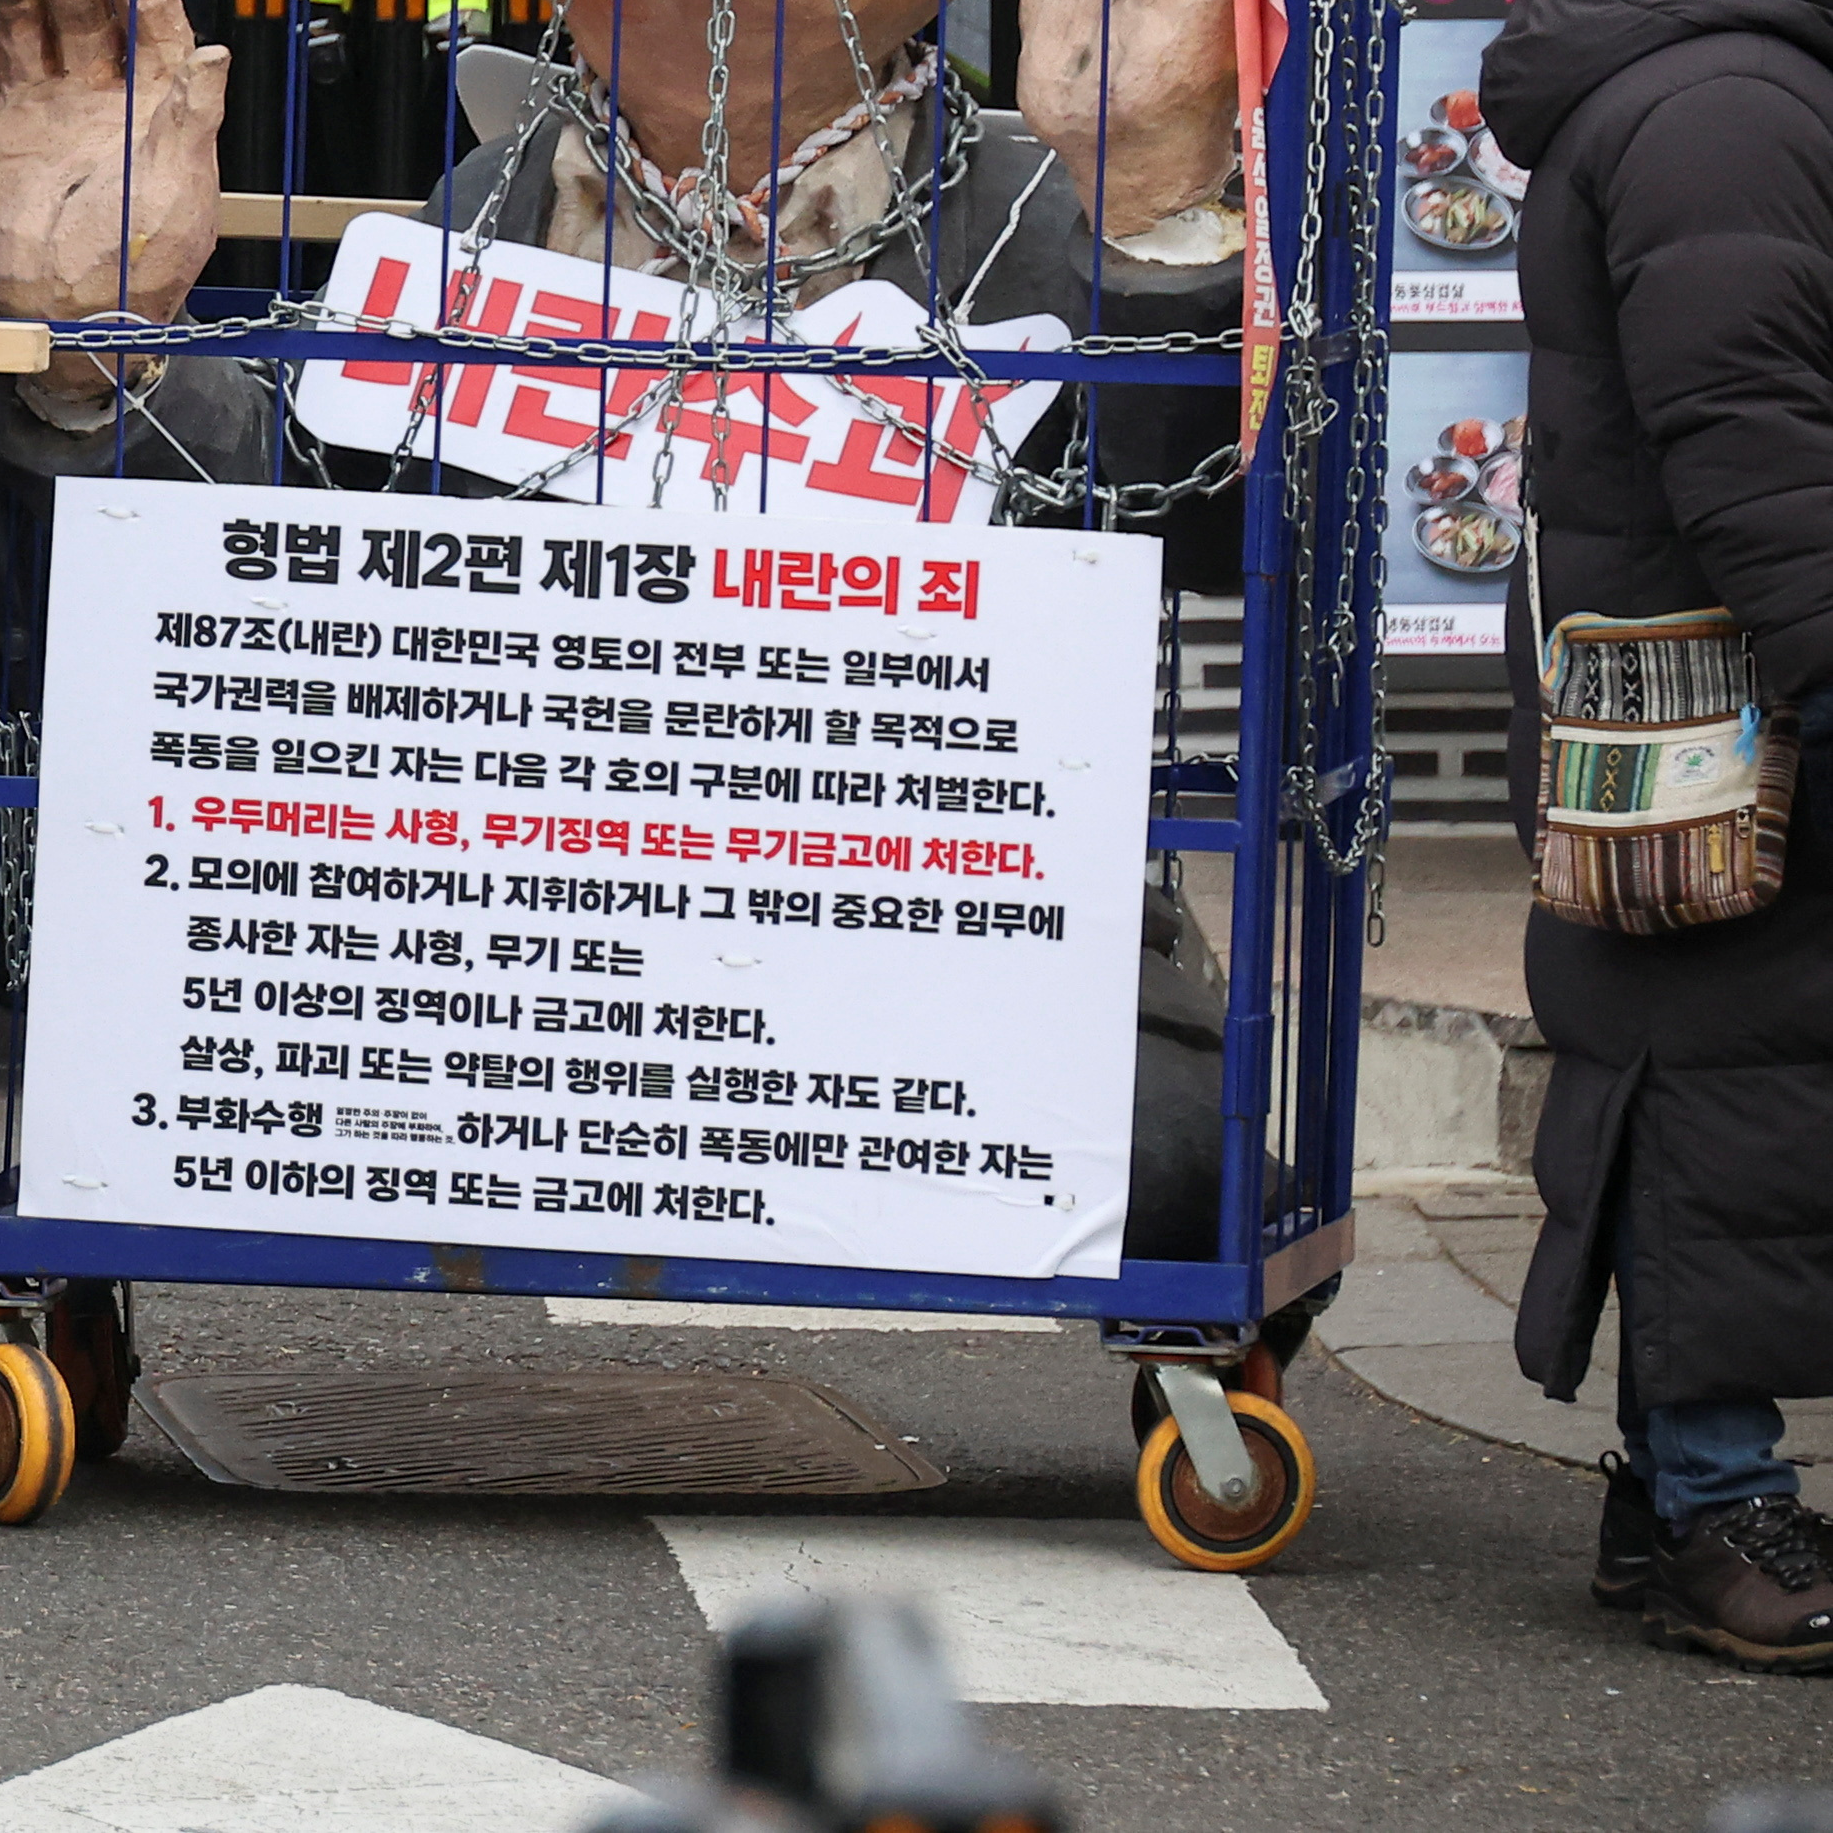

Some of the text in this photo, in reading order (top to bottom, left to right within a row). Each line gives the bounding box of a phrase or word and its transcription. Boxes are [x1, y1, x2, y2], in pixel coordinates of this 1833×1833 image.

[341, 256, 1030, 524] 내란수괴
[222, 518, 980, 620] 형법 제2편 제1장 내란의 죄
[154, 612, 990, 693] 제87조(내란) 대한민국 영토의 전부 또는 일부에서
[153, 671, 1018, 753] 국가권력을 배제하거나 국헌을 문란하게 할 목적으로
[148, 795, 1044, 880] 1. 우두머리는 사형, 무기징역 또는 무기금고에 처한다.
[143, 853, 1065, 941] 2. 모의에 참여하거나 지휘하거나 그 밖의 중요한 임무에
[149, 731, 1056, 1141] 폭동을 일으킨 자는 다음 각 호의 구분에 따라 처벌한다.
[186, 915, 644, 977] 종사한 자는 사형, 무기 또는
[182, 976, 776, 1046] 5년 이상의 징역이나 금고에 처한다.
[180, 1035, 976, 1118] 살상, 파괴 또는 약탈의 행위를 실행한 자도 같다.
[131, 1092, 1054, 1181] 3. 부화수행 하거나 단순히 폭동에만 관여한 자는
[173, 1155, 775, 1227] 5년 이하의 징역 또는 금고에 처한다.
